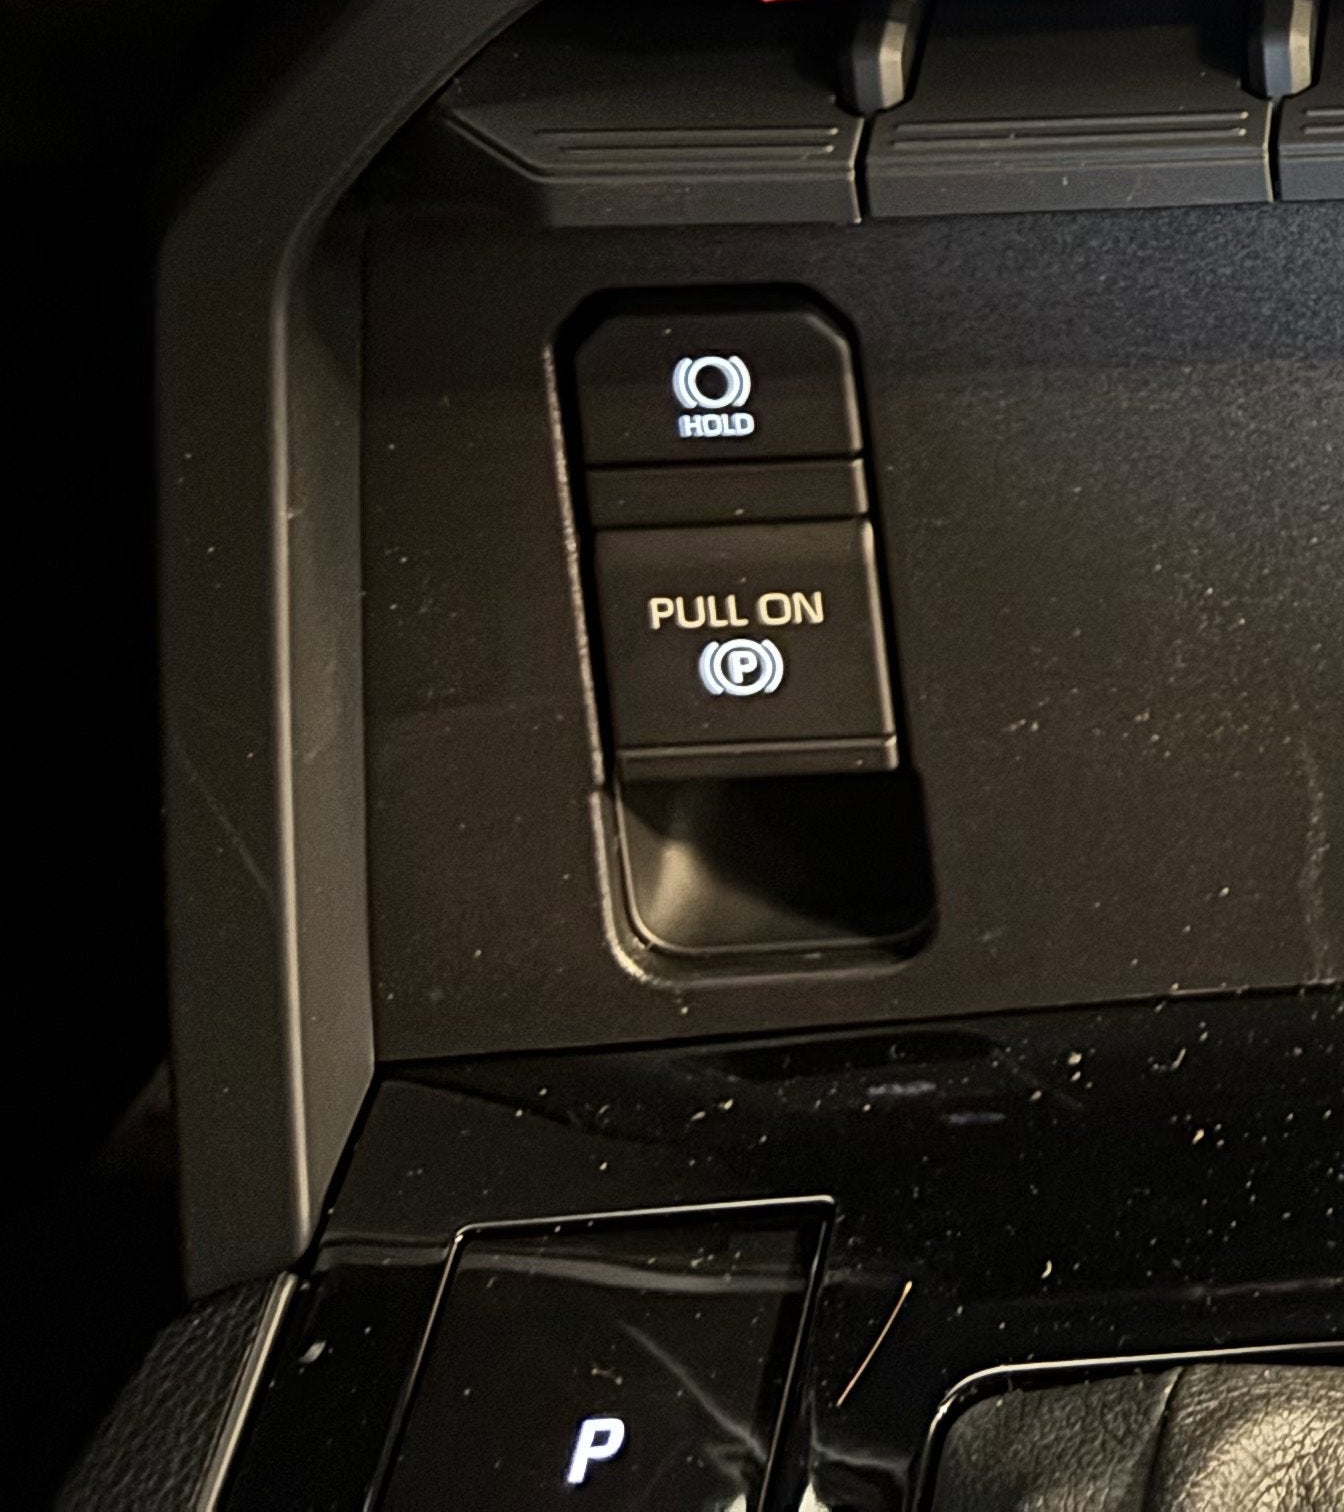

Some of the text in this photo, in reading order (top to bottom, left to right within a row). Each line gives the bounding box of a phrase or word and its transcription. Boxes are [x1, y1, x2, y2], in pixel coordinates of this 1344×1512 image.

[678, 412, 755, 438] HOLD
[648, 590, 825, 630] PULL ON
[565, 1416, 626, 1486] P
